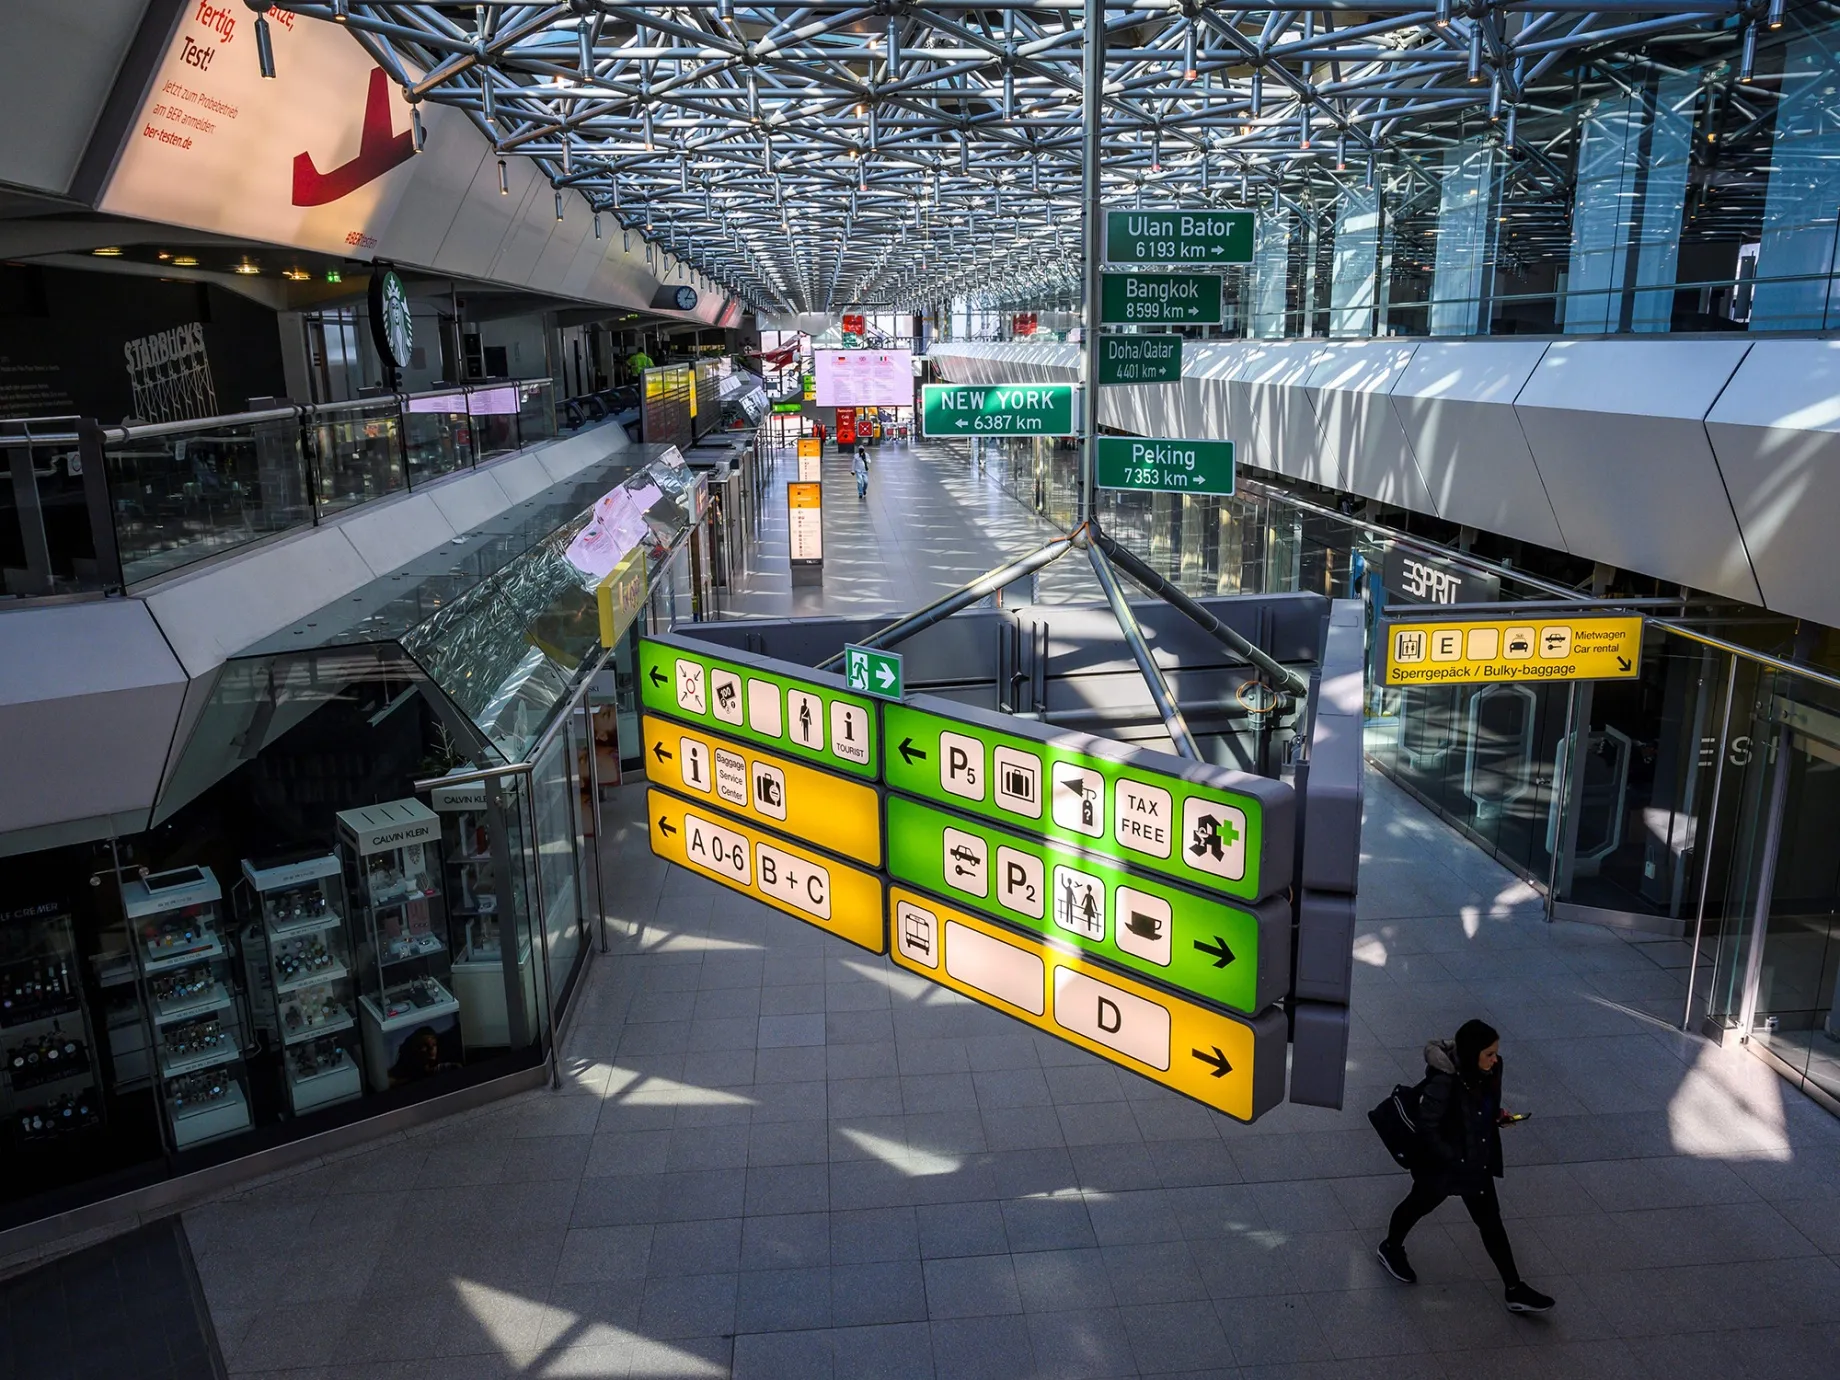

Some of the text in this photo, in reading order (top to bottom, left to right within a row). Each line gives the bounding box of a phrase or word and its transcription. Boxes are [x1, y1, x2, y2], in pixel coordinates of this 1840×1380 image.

[195, 0, 236, 43] fertig,
[180, 36, 215, 71] Test!
[162, 80, 239, 119] Jetzt zum Probebetrieb
[153, 103, 166, 117] am
[166, 106, 183, 122] BER
[143, 123, 193, 150] ber-testen.de
[1128, 216, 1235, 237] Ulan Bator
[1180, 242, 1206, 258] km
[1126, 278, 1199, 302] Bangkok
[1163, 303, 1184, 318] km
[124, 321, 205, 374] STARBUCKS
[1108, 340, 1174, 360] Doha/Qatar
[1141, 364, 1157, 378] km
[941, 390, 1055, 410] NEW YORK
[974, 415, 1042, 430] 6387 km
[1132, 444, 1196, 469] Peking
[1164, 470, 1188, 487] km
[1402, 558, 1462, 604] ESPRIT
[1441, 638, 1453, 654] E
[1574, 630, 1626, 642] Mietwagen
[1574, 643, 1619, 654] Car rental
[1391, 664, 1576, 681] Sperrgepäck / Bulky-baggage
[844, 712, 855, 741] i
[836, 742, 864, 758] TOURIST
[690, 747, 701, 784] i
[716, 753, 744, 771] Baggage
[719, 769, 743, 785] Service
[444, 796, 473, 804] CALVIN
[721, 785, 743, 800] Center
[1127, 794, 1159, 817] TAX
[372, 827, 429, 846] CALVIN KLEIN
[1121, 818, 1165, 844] FREE
[692, 828, 744, 871] A 0-6
[762, 855, 777, 884] B
[807, 875, 824, 905] C
[1097, 996, 1122, 1034] D
